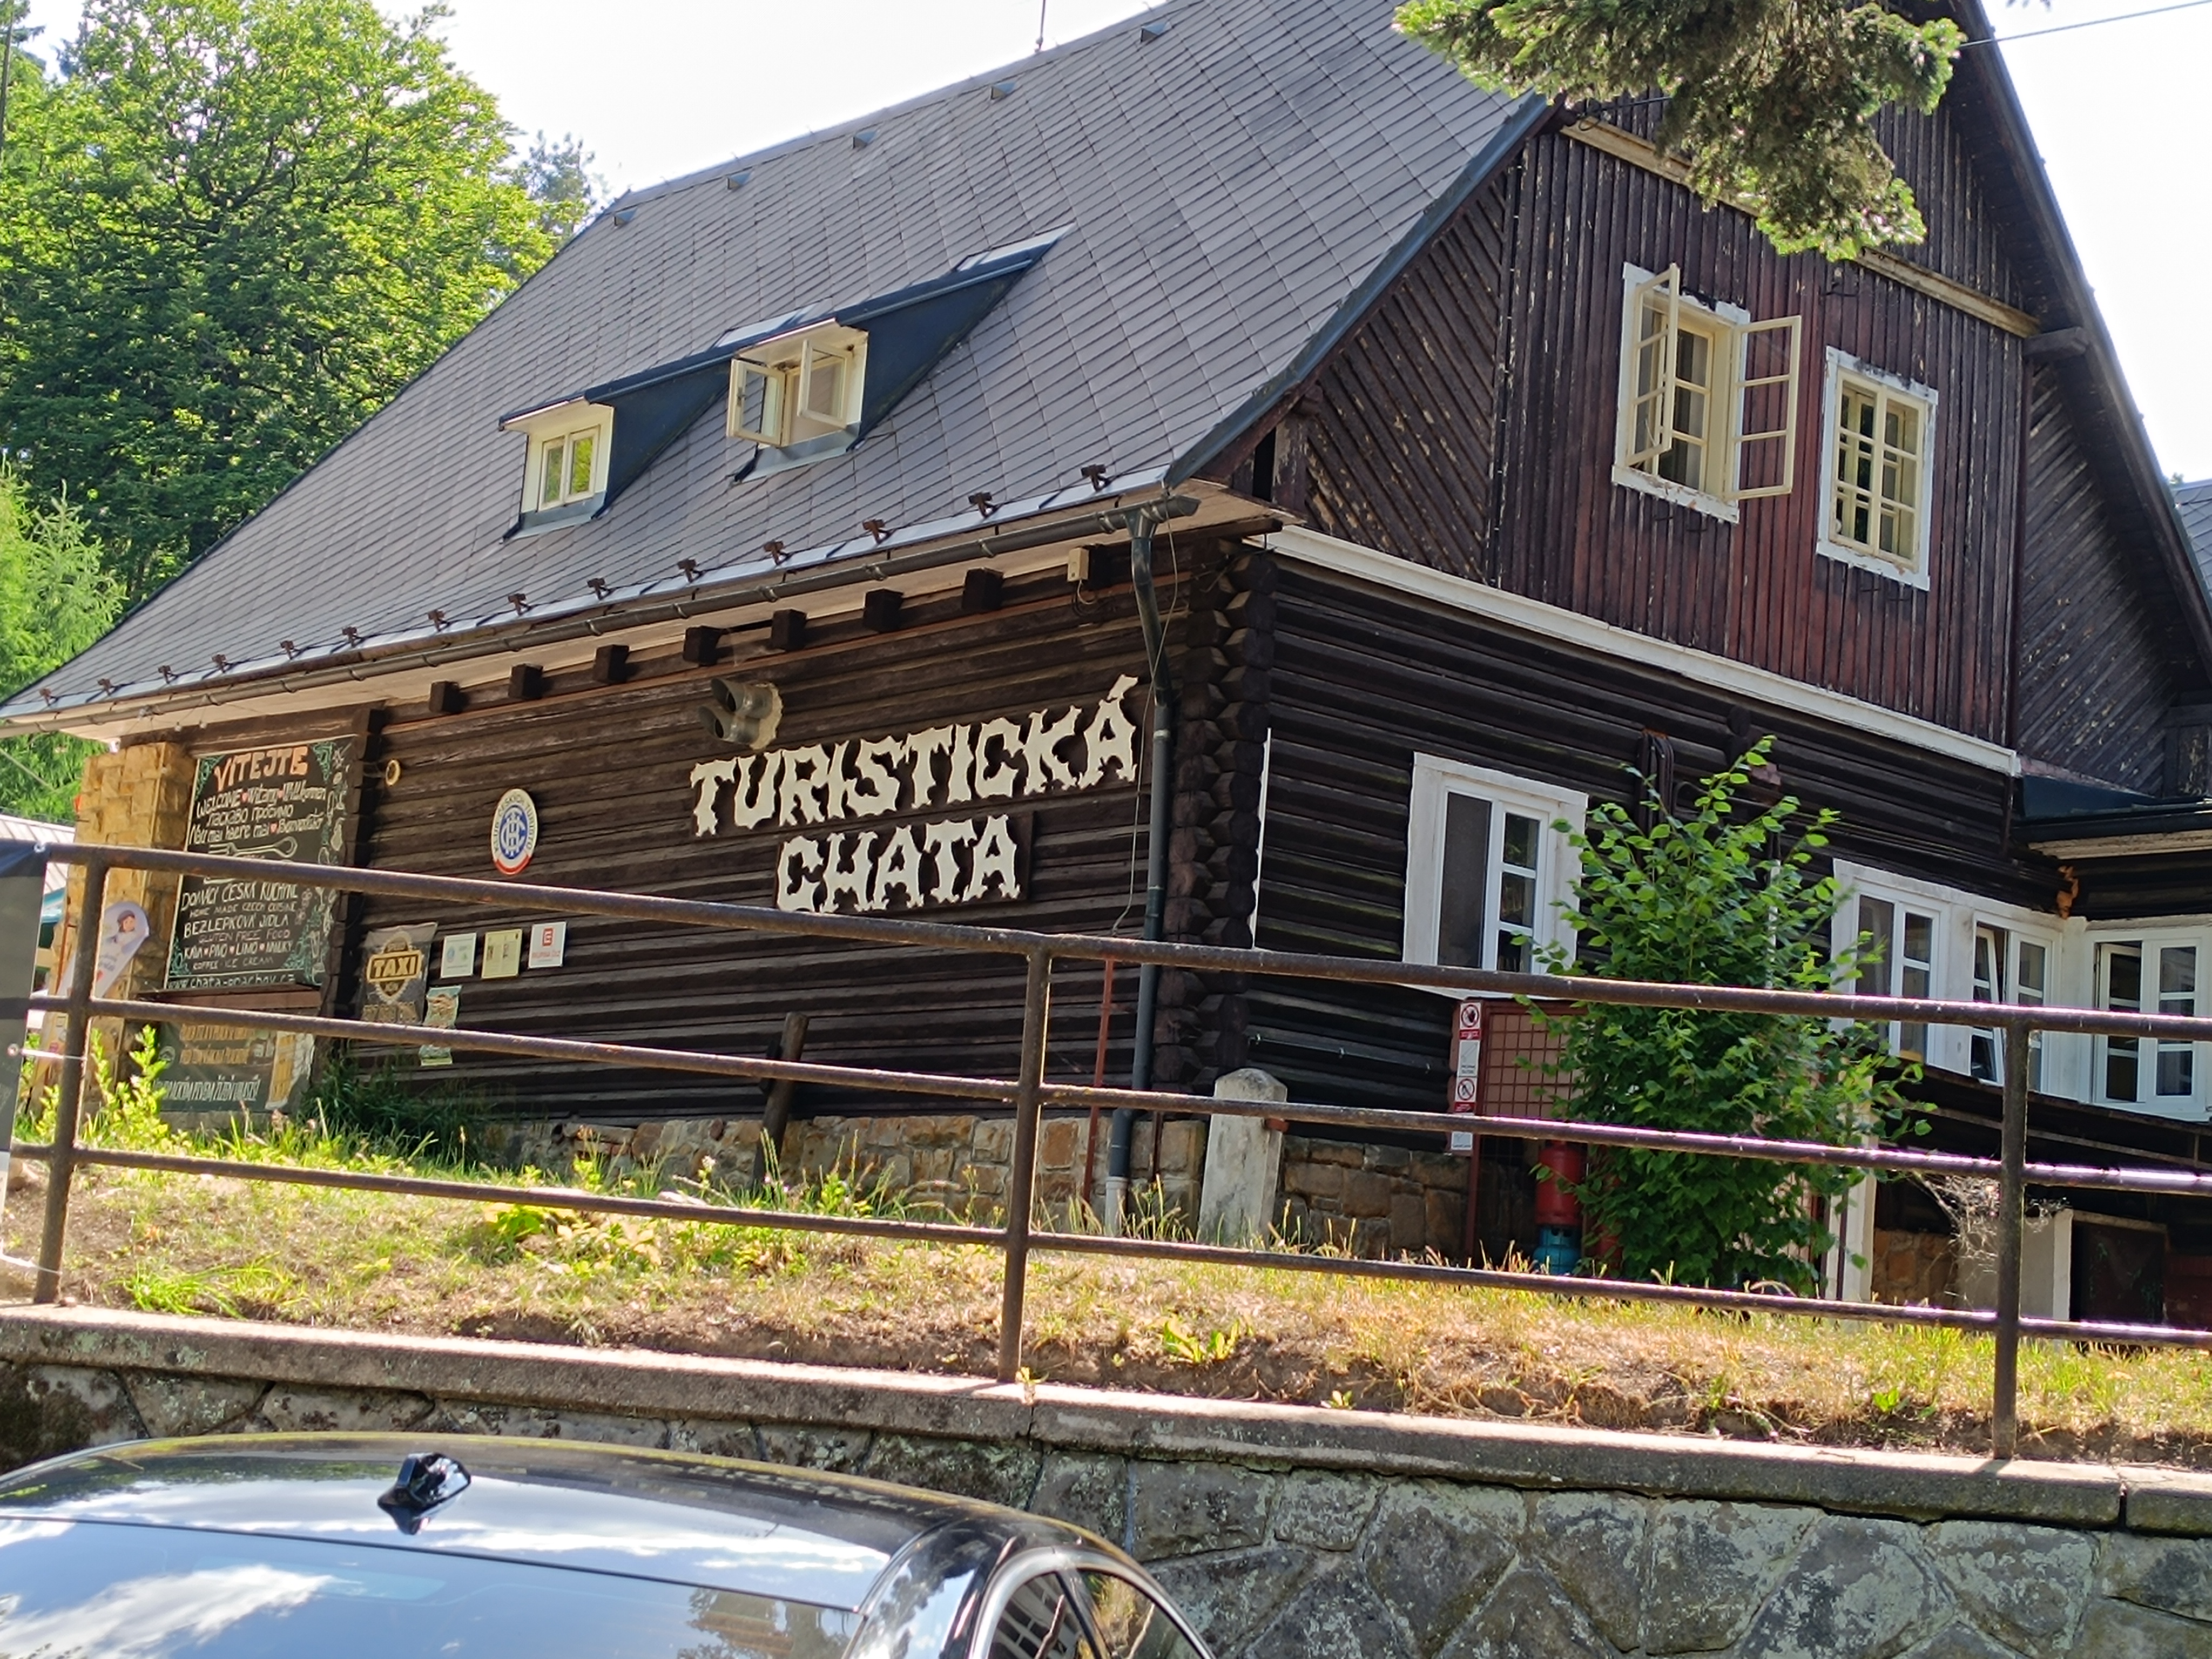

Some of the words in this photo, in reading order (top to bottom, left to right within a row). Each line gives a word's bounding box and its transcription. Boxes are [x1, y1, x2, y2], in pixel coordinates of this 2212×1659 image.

[690, 673, 1138, 838] TURISTICKÁ
[197, 788, 242, 819] WELCOME
[775, 814, 1021, 913] CHATA
[190, 907, 210, 918] HOME
[214, 904, 239, 914] MADE
[242, 902, 265, 912] CZECH
[268, 901, 297, 912] CUISINE
[198, 932, 233, 943] GLUTEN
[235, 929, 261, 941] FREE
[267, 929, 290, 940] FOOD
[236, 941, 258, 956] LIMO
[193, 961, 218, 970] COFFEE
[225, 959, 238, 968] ICE
[244, 956, 273, 966] CREAM
[374, 956, 416, 977] TAXI
